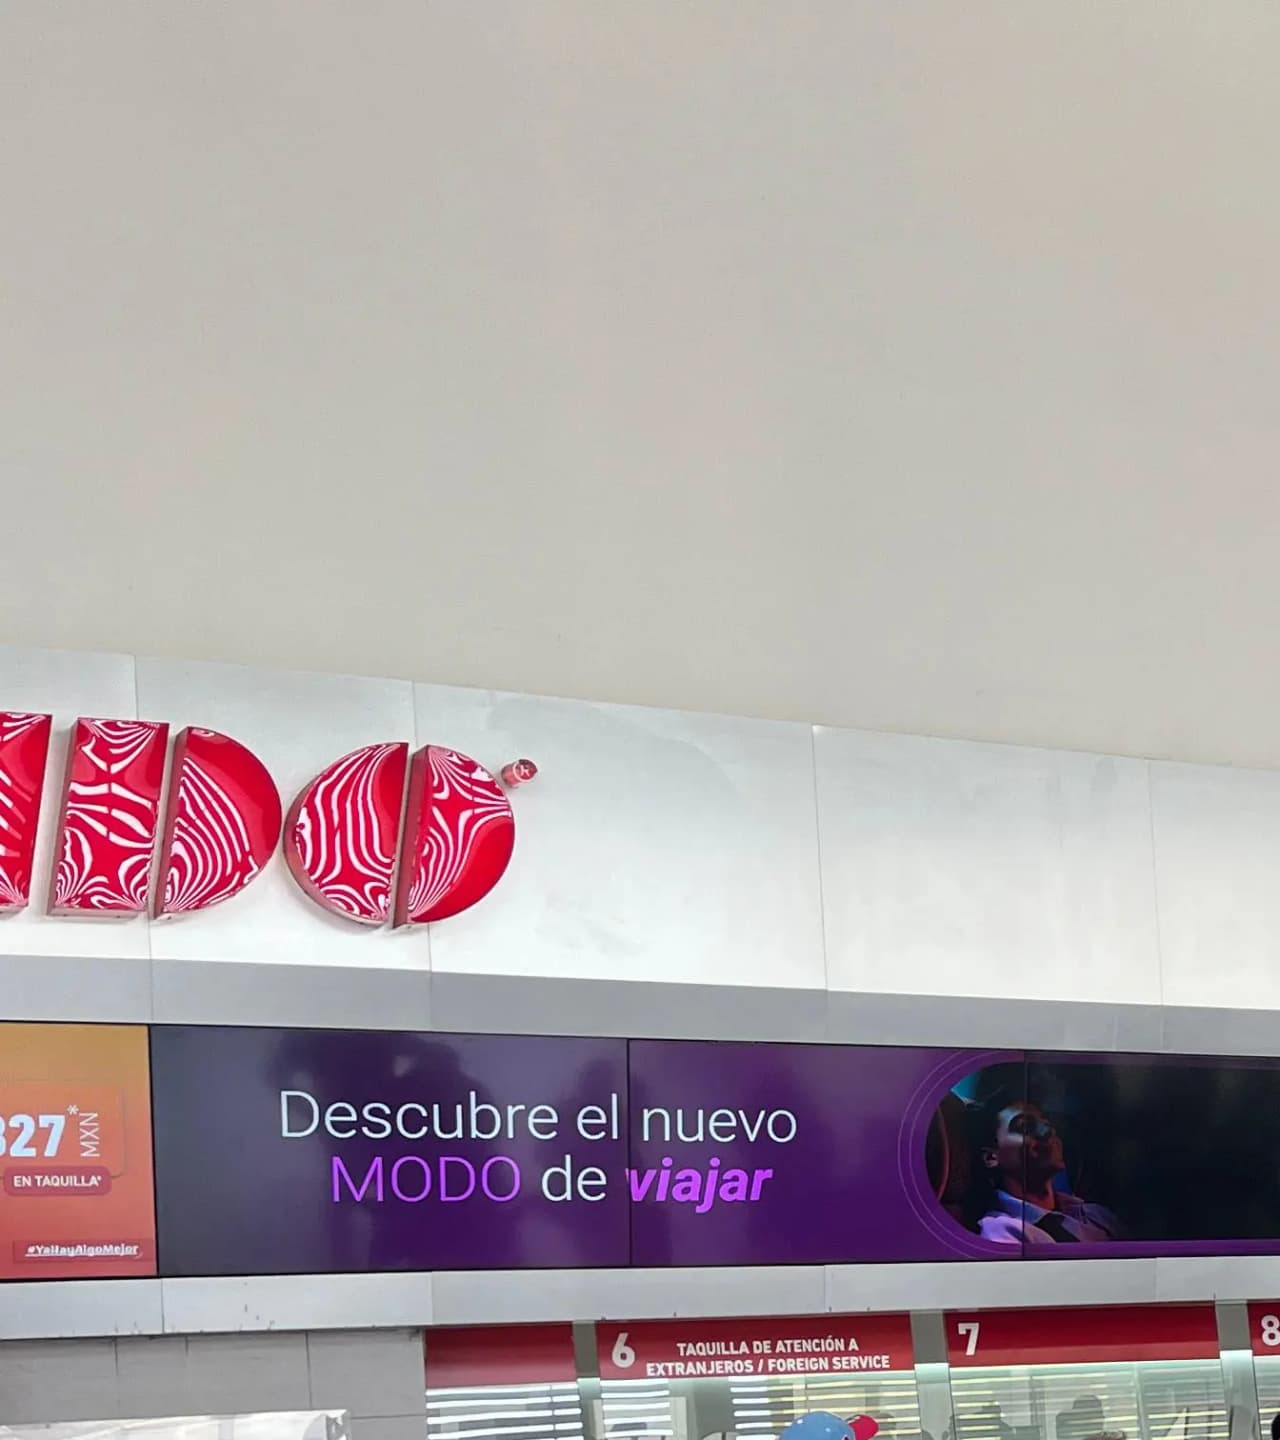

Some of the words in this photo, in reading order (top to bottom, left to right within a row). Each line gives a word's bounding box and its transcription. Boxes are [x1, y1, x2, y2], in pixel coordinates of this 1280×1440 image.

[79, 1112, 100, 1158] MXN
[280, 1090, 558, 1140] Descubre
[577, 1093, 619, 1141] el
[643, 1106, 797, 1143] nuevo
[13, 1175, 32, 1188] EN
[331, 1156, 521, 1203] MODO
[541, 1154, 607, 1202] de
[625, 1157, 773, 1214] viajar
[611, 1332, 636, 1369] 6
[677, 1341, 750, 1357] TAQUILLA
[753, 1340, 771, 1354] DE
[775, 1335, 843, 1353] ATENCIÓN
[849, 1337, 859, 1351] A
[958, 1322, 981, 1356] 7
[646, 1360, 754, 1377] EXTRANJEROS
[757, 1358, 764, 1372] /
[768, 1357, 828, 1371] FOREIGN
[832, 1355, 890, 1369] SERVICE
